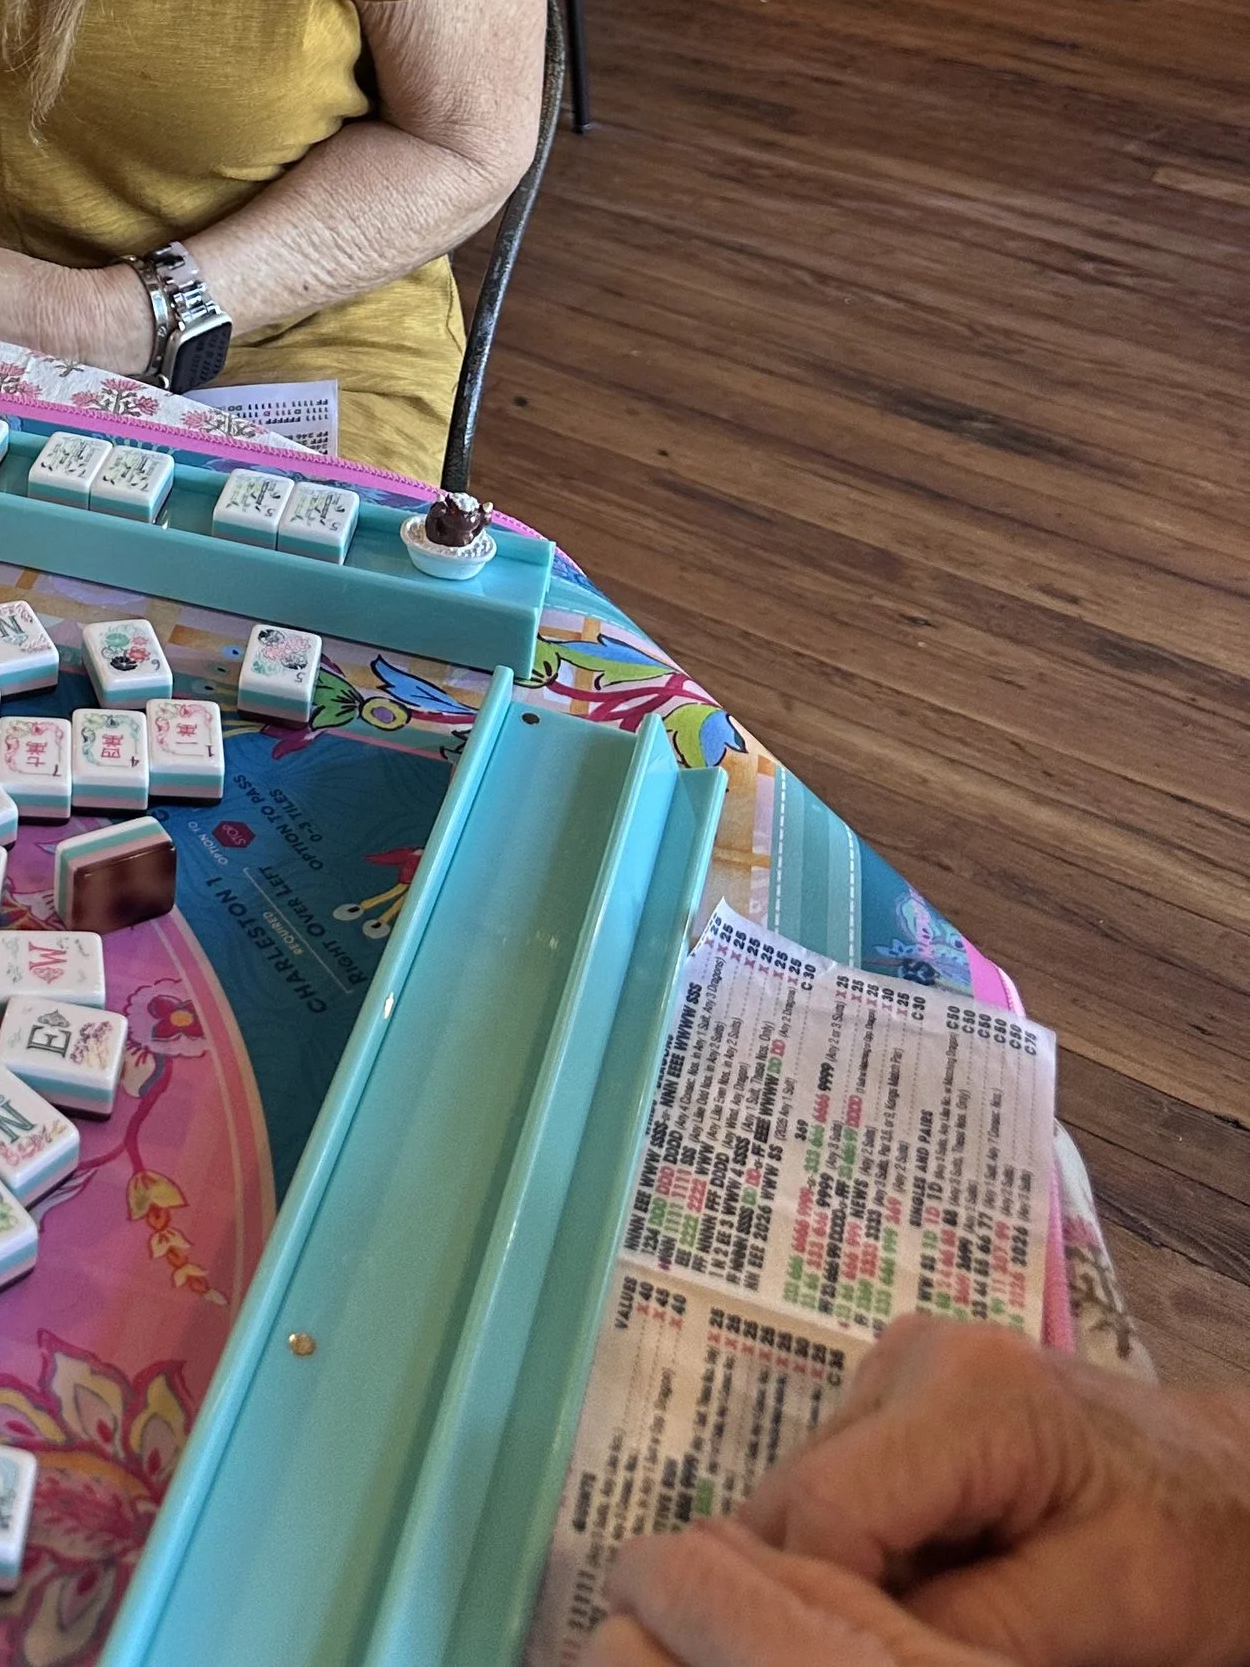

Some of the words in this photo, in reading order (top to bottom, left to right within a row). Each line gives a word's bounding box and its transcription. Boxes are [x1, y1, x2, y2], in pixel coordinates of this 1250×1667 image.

[293, 672, 305, 683] 5
[50, 765, 61, 777] 7
[130, 756, 140, 767] 4
[233, 774, 264, 804] PASS
[261, 805, 282, 823] TO
[269, 788, 304, 818] TILES
[222, 824, 246, 845] STOP
[277, 824, 324, 871] OPTION
[201, 833, 229, 866] OPTION
[258, 866, 292, 897] LEFT
[287, 897, 326, 938] OVER
[262, 911, 303, 955] REQUIRED
[732, 930, 747, 949] 25
[28, 941, 67, 971] W
[215, 888, 327, 1014] CHARLESTON
[322, 939, 368, 985] RIGHT
[788, 957, 802, 975] 25
[803, 963, 816, 980] 30
[685, 981, 703, 1005] SSS
[801, 980, 812, 991] C
[836, 973, 849, 989] 25
[865, 982, 879, 997] 25
[911, 1010, 924, 1021] C
[912, 995, 926, 1011] 30
[946, 1003, 960, 1021] 50
[962, 1008, 976, 1025] 50
[673, 1004, 697, 1052] WWWW
[945, 1019, 958, 1030] C
[961, 1023, 974, 1035] C
[977, 1028, 990, 1039] C
[978, 1011, 991, 1029] 50
[1009, 1022, 1022, 1040] 50
[26, 1025, 71, 1058] E
[993, 1032, 1006, 1044] C
[1009, 1038, 1021, 1050] C
[1024, 1030, 1036, 1045] 75
[1024, 1044, 1036, 1056] C
[666, 1052, 685, 1079] EEEE
[694, 1140, 716, 1177] WWW
[746, 936, 760, 956] 25
[709, 1150, 731, 1189] DDDD
[760, 943, 774, 963] 25
[640, 1226, 660, 1255] 1234
[662, 1129, 683, 1165] DDDD
[707, 955, 727, 993] Dragons)
[719, 922, 733, 942] 25
[721, 1175, 743, 1218] WWW
[774, 950, 788, 969] 25
[816, 1171, 834, 1208] 9999
[850, 977, 864, 993] 25
[849, 1177, 868, 1219] NEWS
[881, 986, 894, 1002] 30
[918, 1108, 933, 1144] PAIRS
[638, 1148, 661, 1189] WWW
[914, 1145, 929, 1173] AND
[759, 1162, 780, 1201] WWW
[632, 1189, 651, 1213] EEE
[908, 1174, 926, 1228] SINGLES
[622, 1213, 645, 1251] NNNN
[752, 1202, 772, 1242] 2026
[1010, 1224, 1028, 1267] 2026
[611, 1276, 640, 1330] VALUES
[636, 1280, 655, 1302] 40
